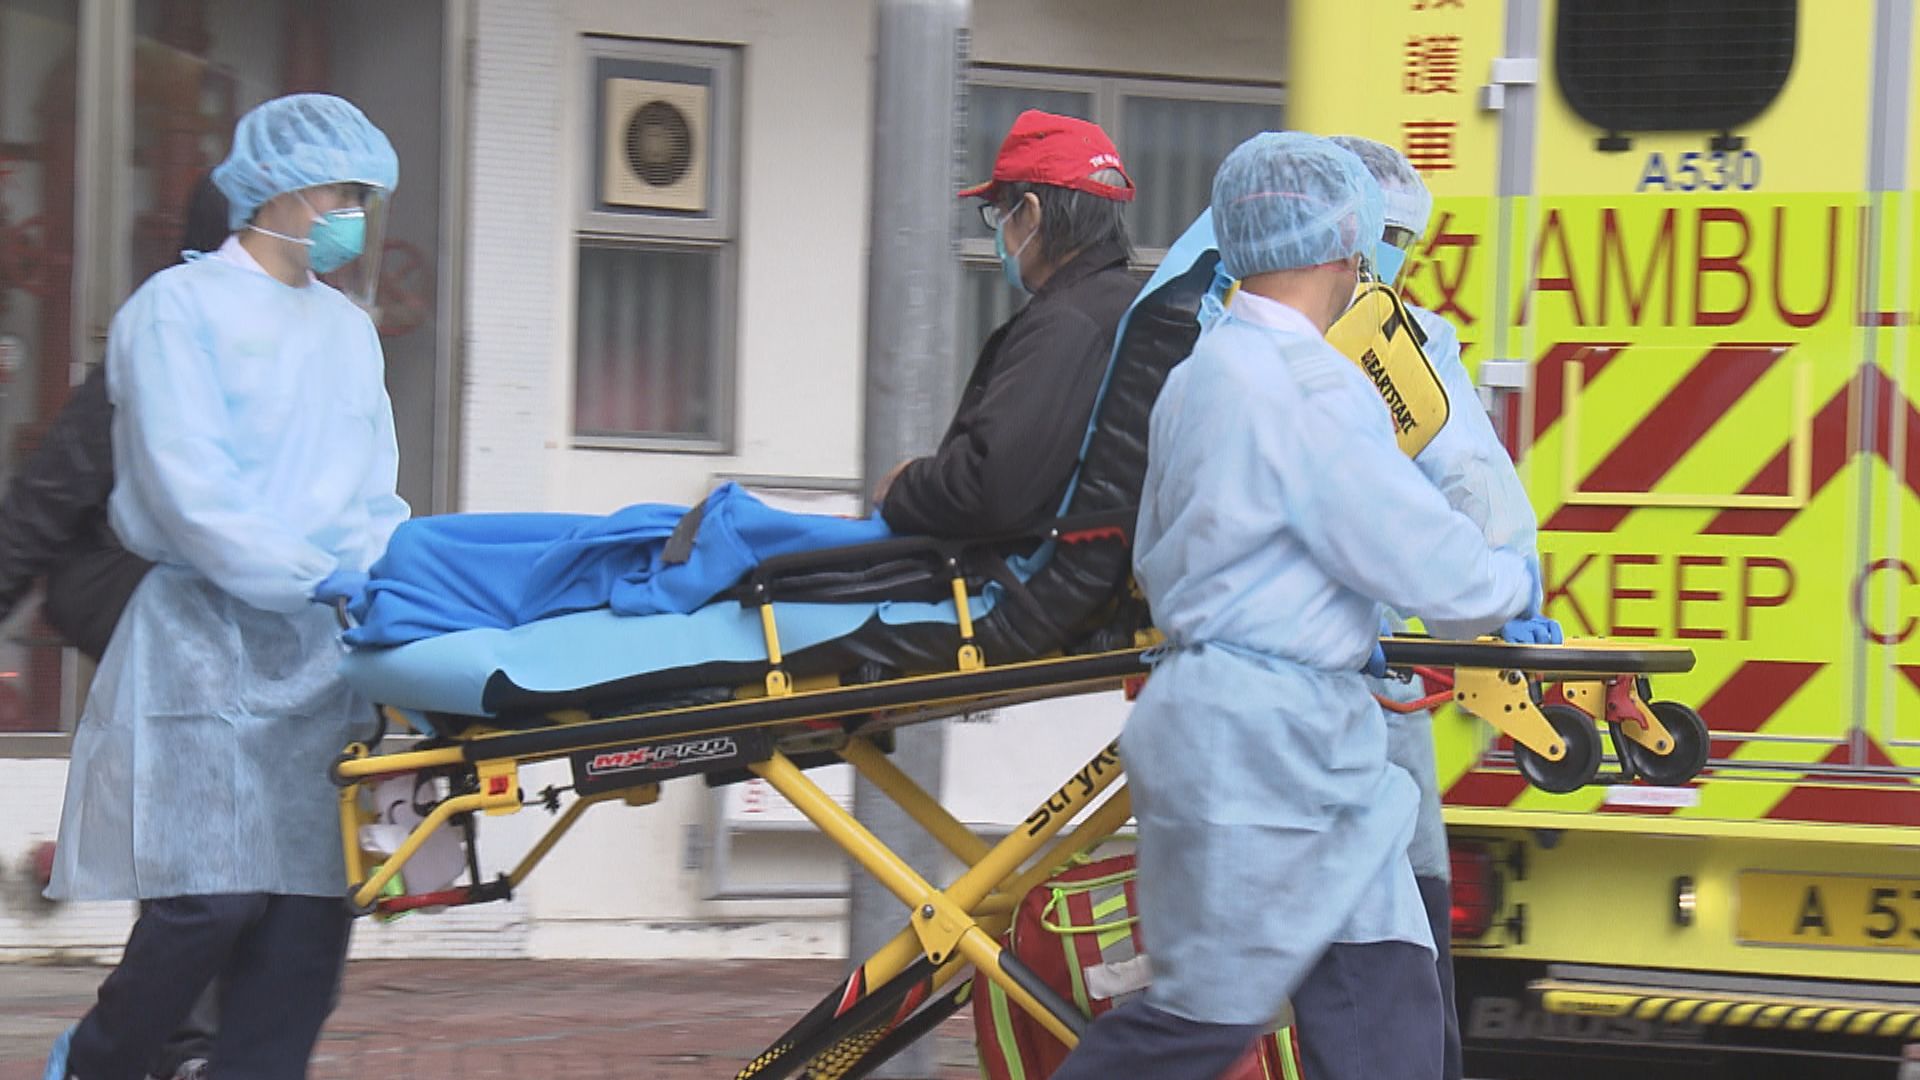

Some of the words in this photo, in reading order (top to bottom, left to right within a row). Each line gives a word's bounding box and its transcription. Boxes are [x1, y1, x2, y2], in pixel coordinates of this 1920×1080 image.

[1403, 0, 1462, 176] 護車
[1635, 151, 1762, 192] A530
[1361, 348, 1418, 434] HEARTSTART
[1543, 552, 1796, 640] KEEP
[592, 737, 729, 769] MX-PRO
[1793, 885, 1832, 936] A
